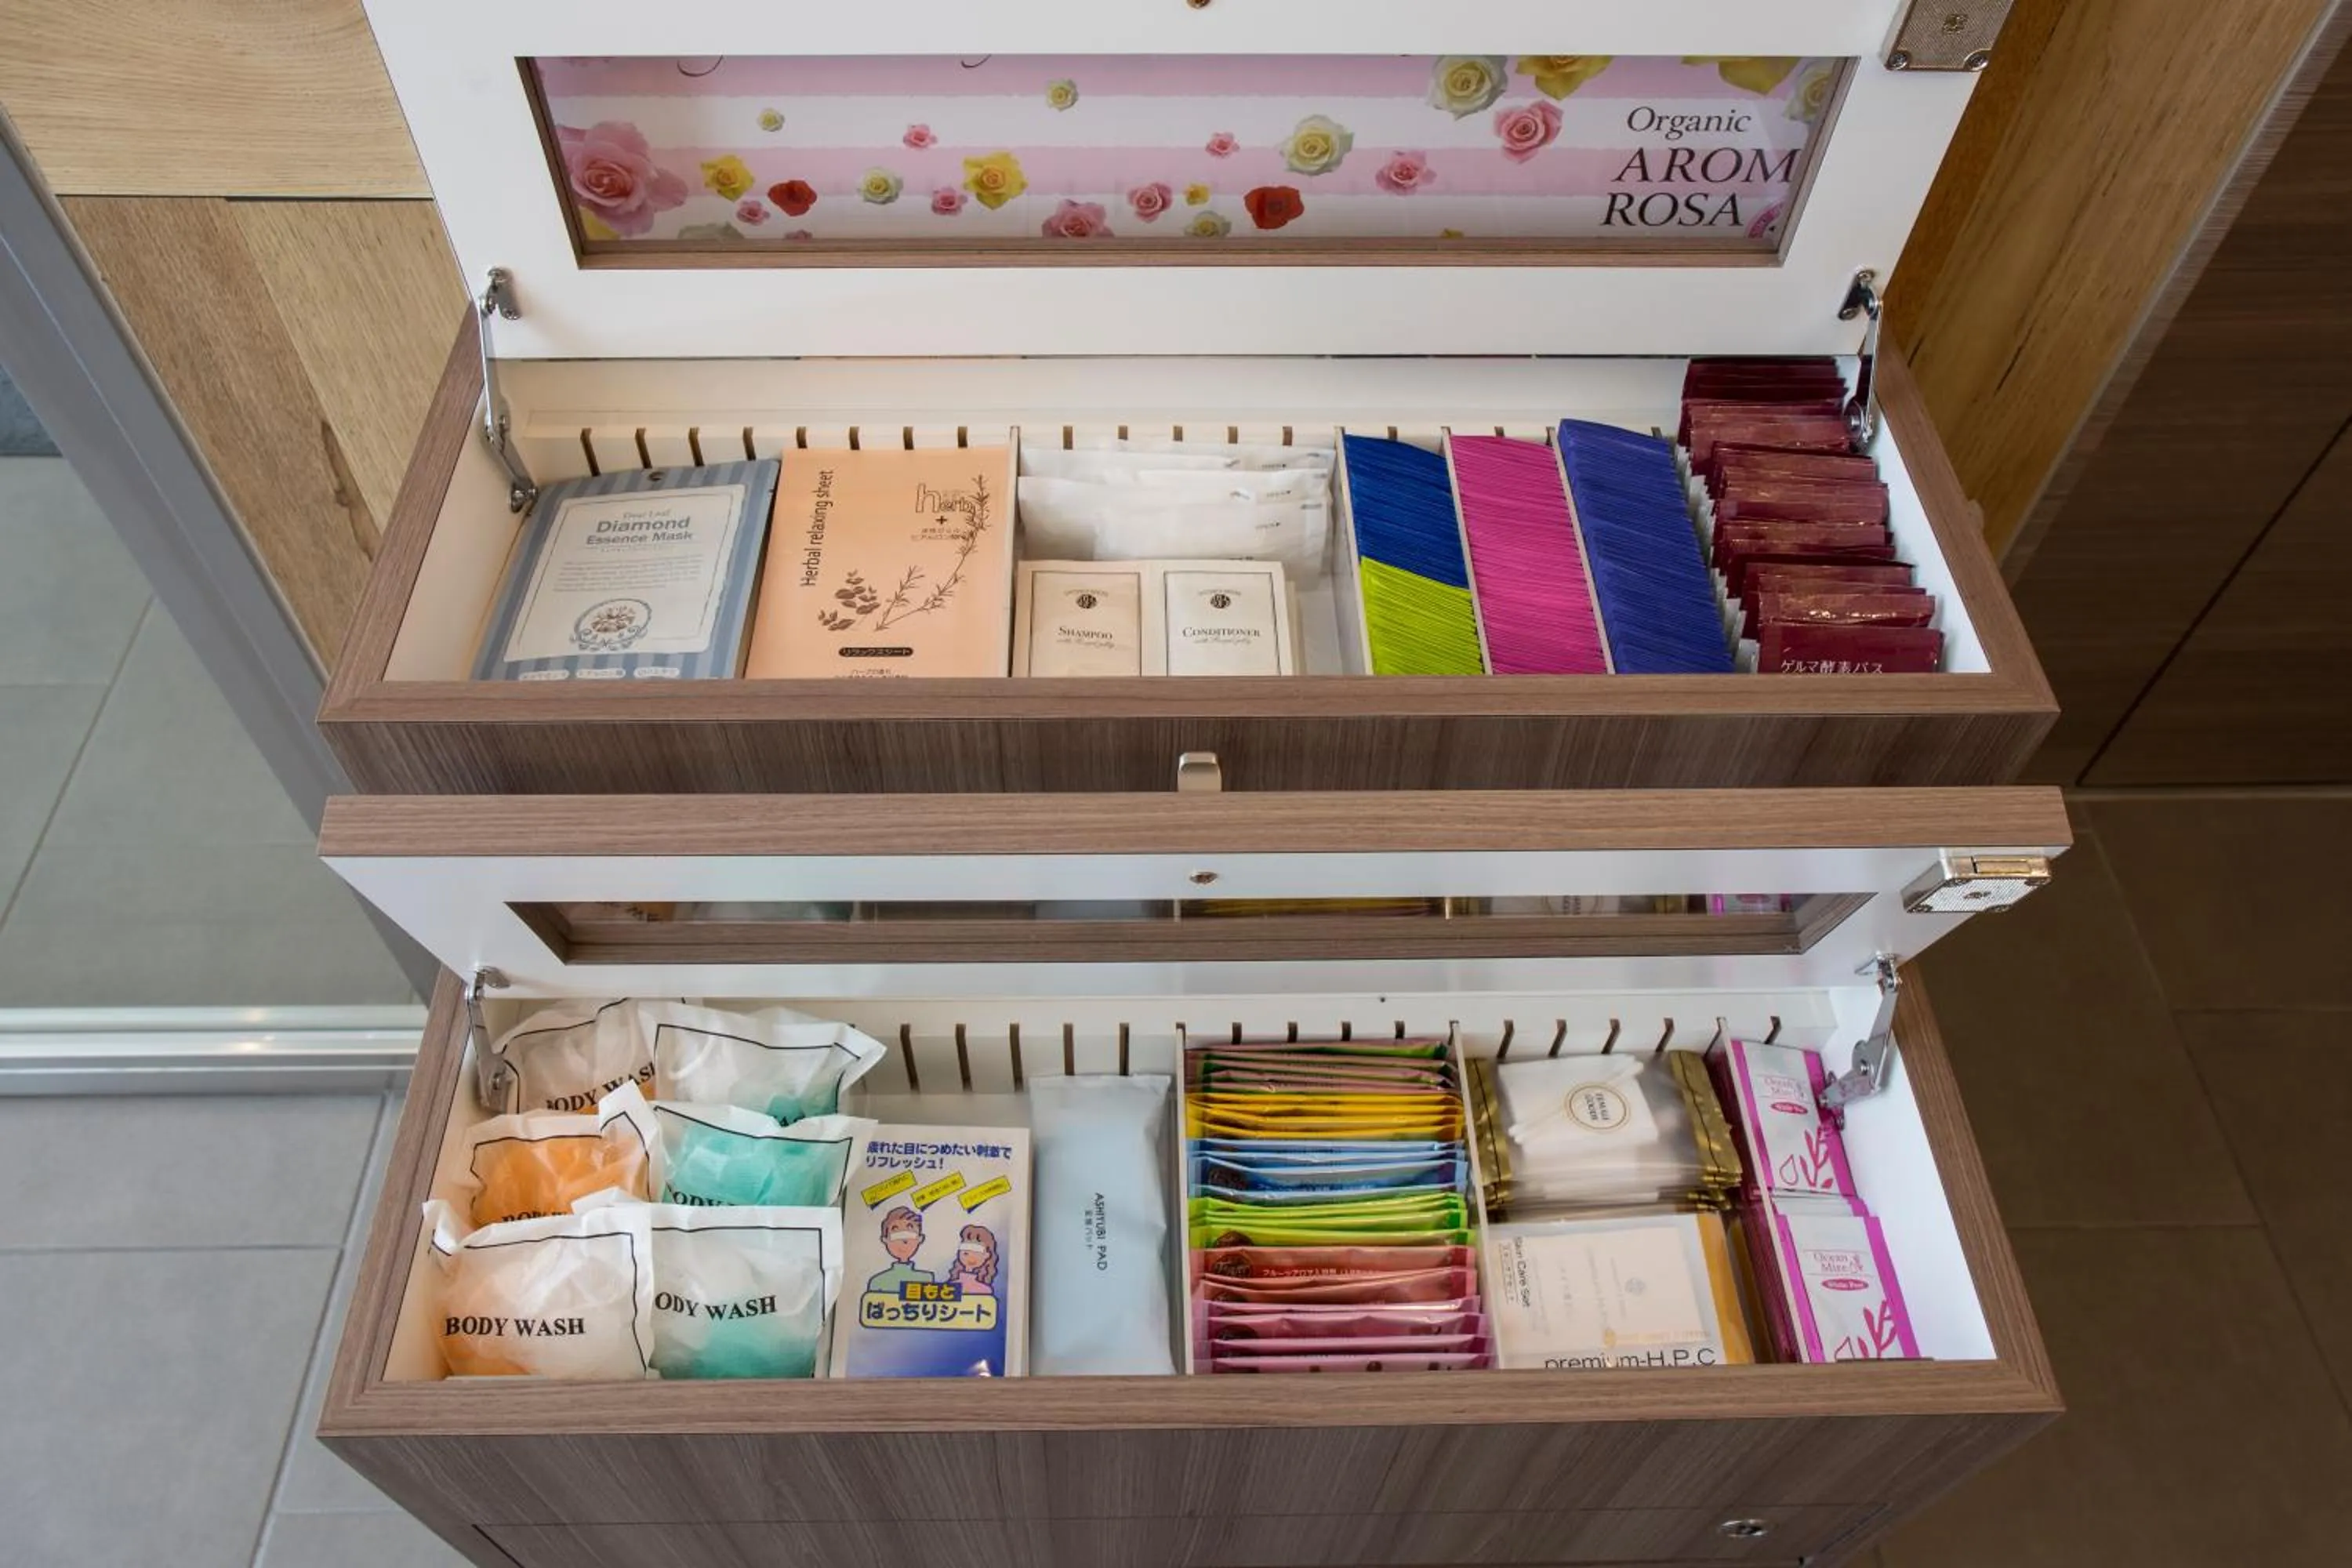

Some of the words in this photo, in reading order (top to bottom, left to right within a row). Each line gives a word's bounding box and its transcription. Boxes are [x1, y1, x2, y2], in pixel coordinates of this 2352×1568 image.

[1627, 105, 1752, 141] Organic
[1600, 191, 1744, 227] ROSA
[811, 469, 835, 499] sheet
[596, 514, 691, 533] Diamond
[806, 499, 834, 546] relaxing
[586, 535, 649, 546] Essence
[652, 530, 694, 543] Mask
[799, 548, 823, 587] Herbal
[1094, 1192, 1106, 1240] ASHIYUBI
[1097, 1244, 1108, 1271] PAD
[1517, 1260, 1526, 1287] Care
[906, 1282, 956, 1300] 目もと
[1521, 1287, 1531, 1308] Set
[704, 1294, 777, 1321] WASH
[445, 1315, 509, 1337] BODY
[514, 1317, 586, 1337] WASH
